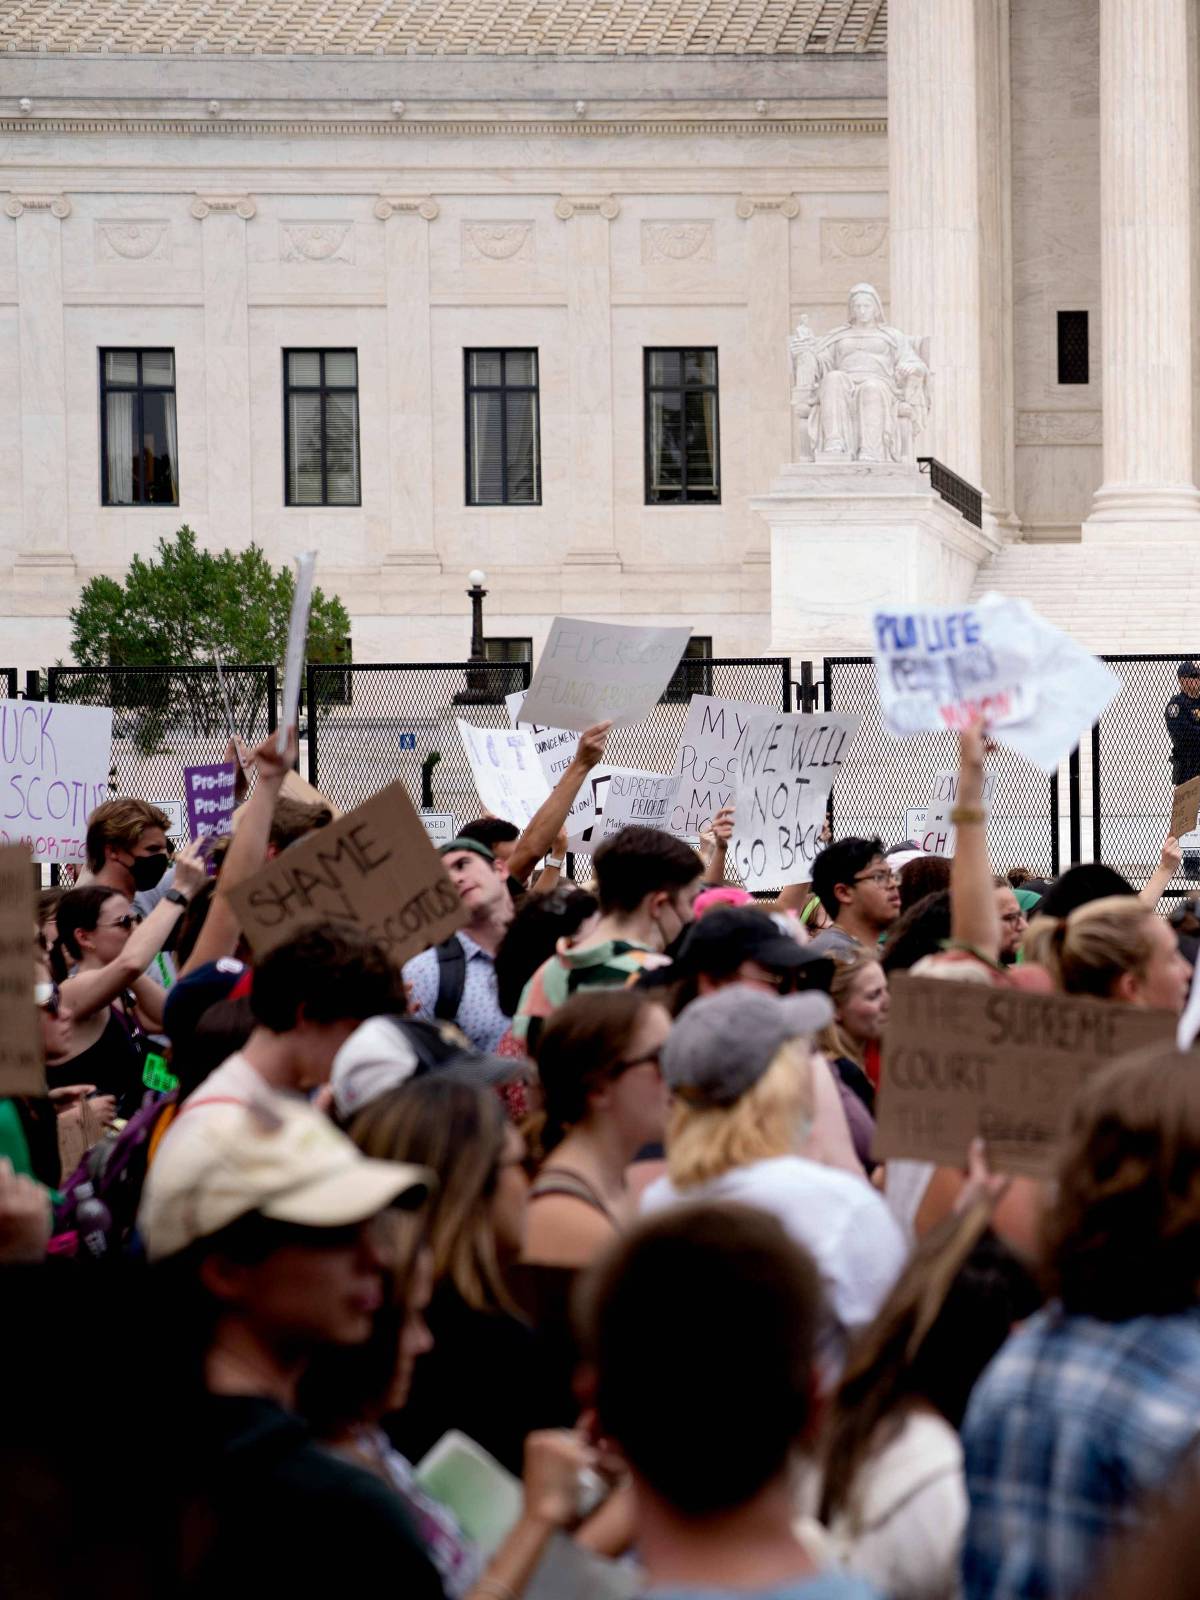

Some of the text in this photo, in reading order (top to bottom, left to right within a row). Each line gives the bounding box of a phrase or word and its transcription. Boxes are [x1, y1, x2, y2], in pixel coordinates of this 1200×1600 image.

[551, 631, 624, 664] FUCK
[0, 705, 58, 776] UCK
[700, 705, 748, 752] MY
[741, 721, 847, 784] WE WILL
[611, 775, 664, 799] SUPREME
[751, 777, 810, 824] NOT
[249, 822, 391, 928] SHAME
[735, 821, 828, 881] GO BACK
[984, 995, 1117, 1056] SUPREME
[888, 1043, 998, 1094] COURT
